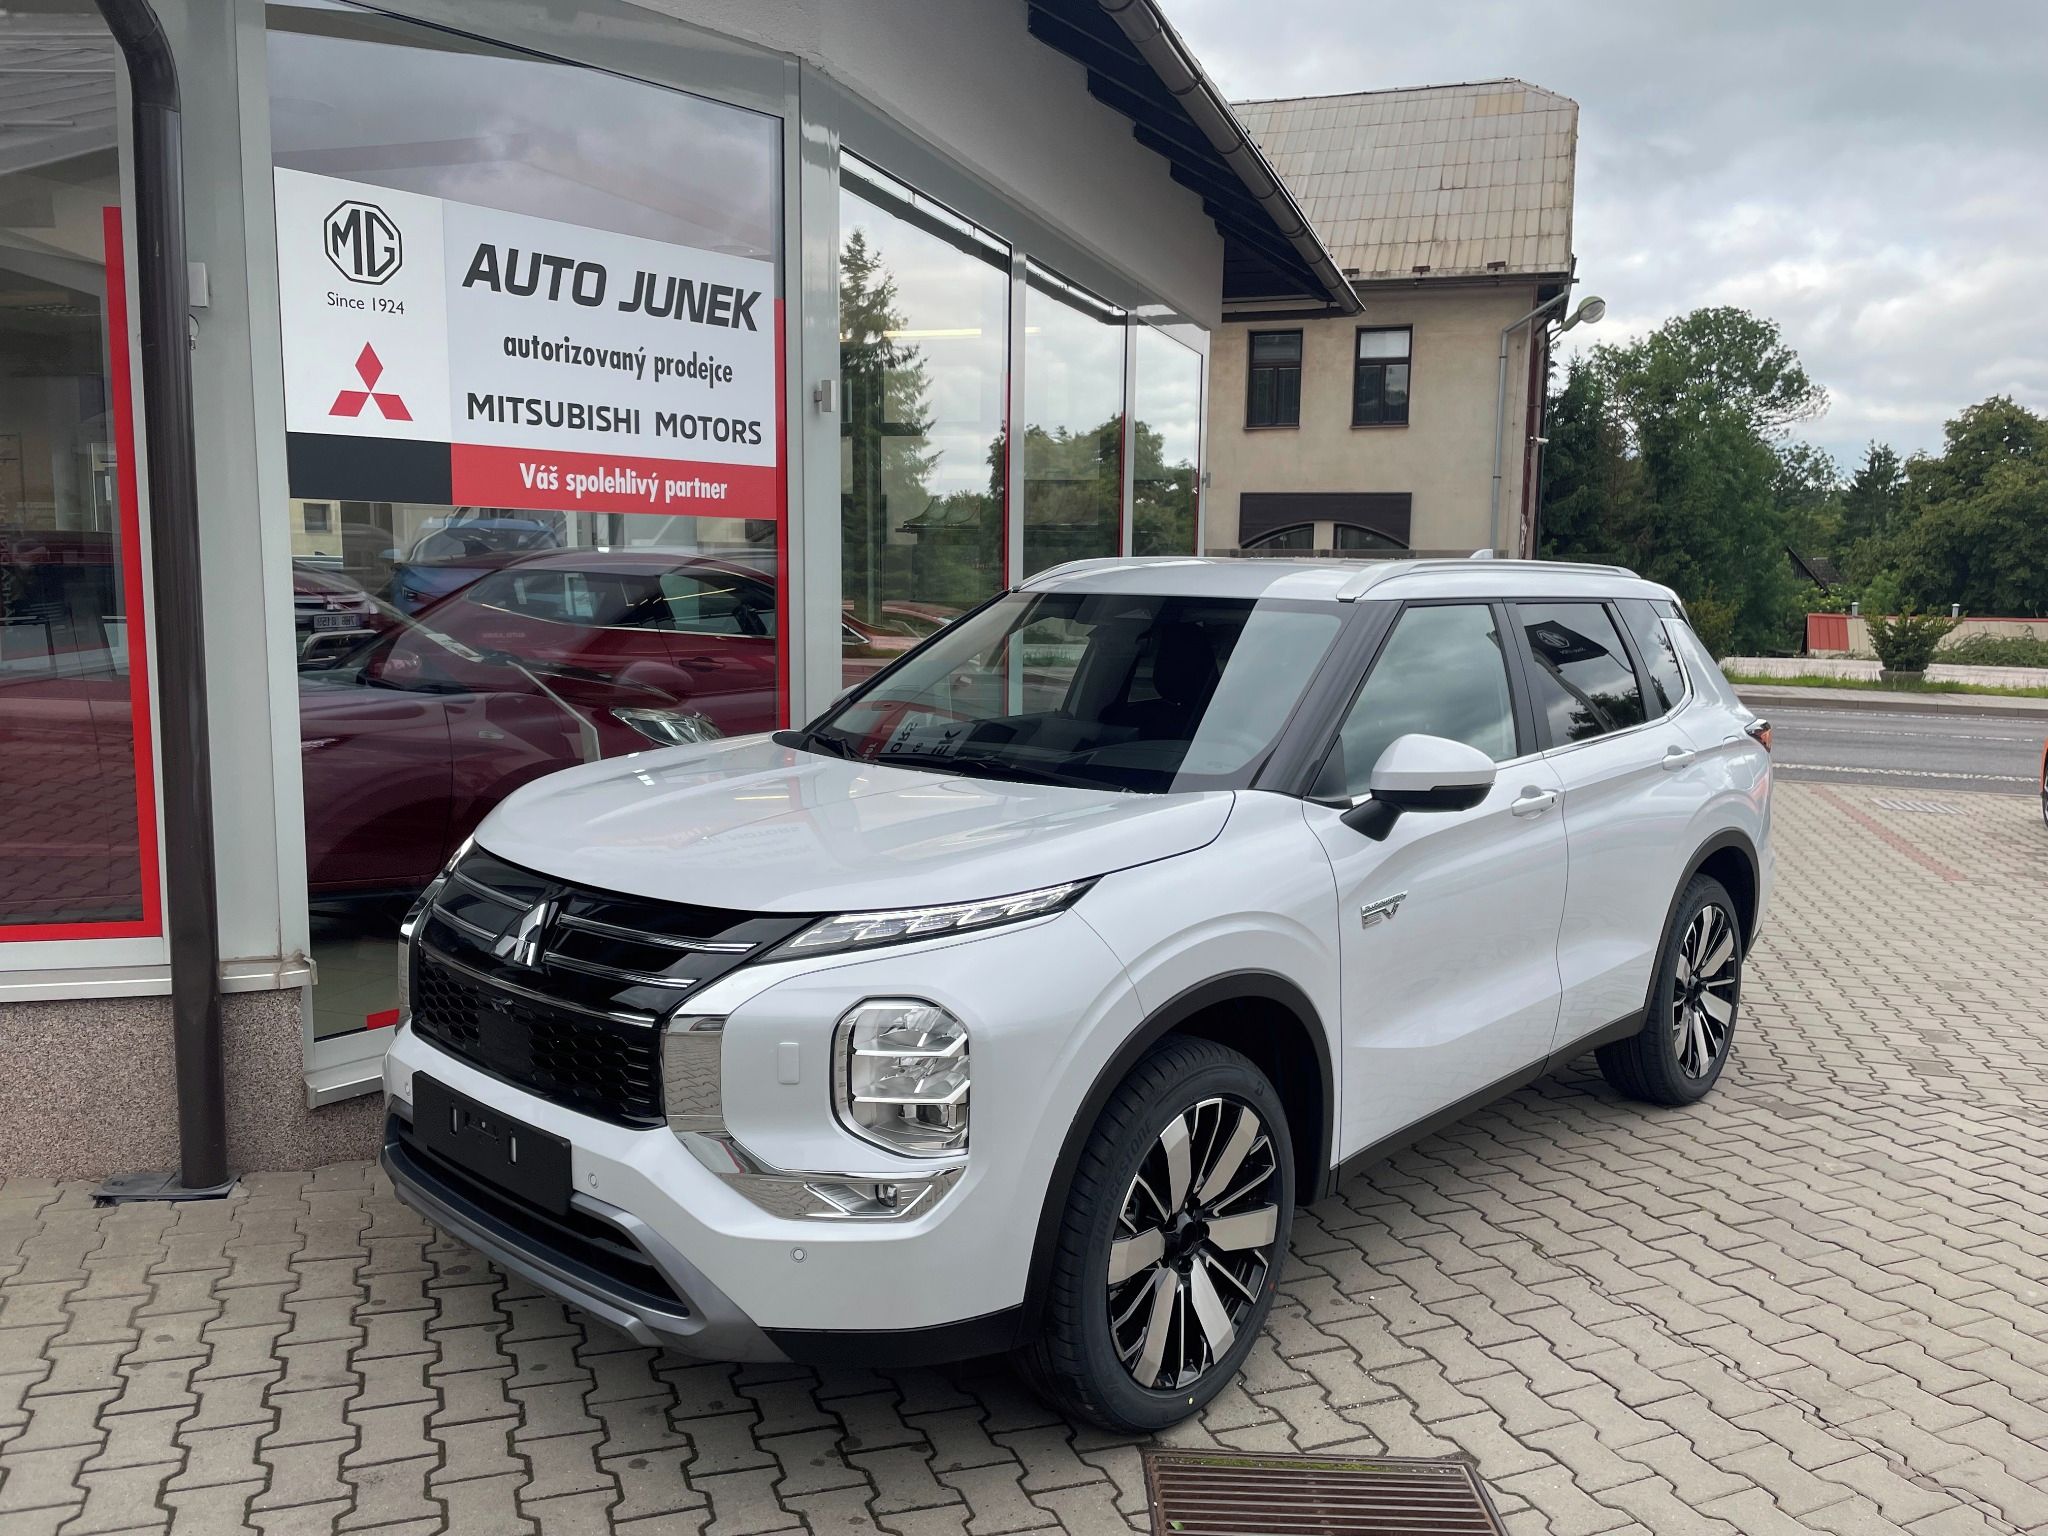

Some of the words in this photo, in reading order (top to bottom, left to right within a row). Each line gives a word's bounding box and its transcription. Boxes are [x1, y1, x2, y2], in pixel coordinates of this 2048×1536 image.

[331, 207, 396, 278] MG
[327, 291, 365, 310] Since
[372, 297, 405, 315] 1924
[462, 242, 607, 307] AUTO
[618, 270, 762, 332] JUNEK
[503, 335, 647, 380] autorizovaný
[653, 351, 734, 389] prodejce
[467, 392, 640, 435] MITSUBISHI
[654, 411, 762, 445] MOTORS
[519, 462, 559, 490] Váš
[565, 466, 660, 503] spolehlivý
[664, 477, 728, 503] partner
